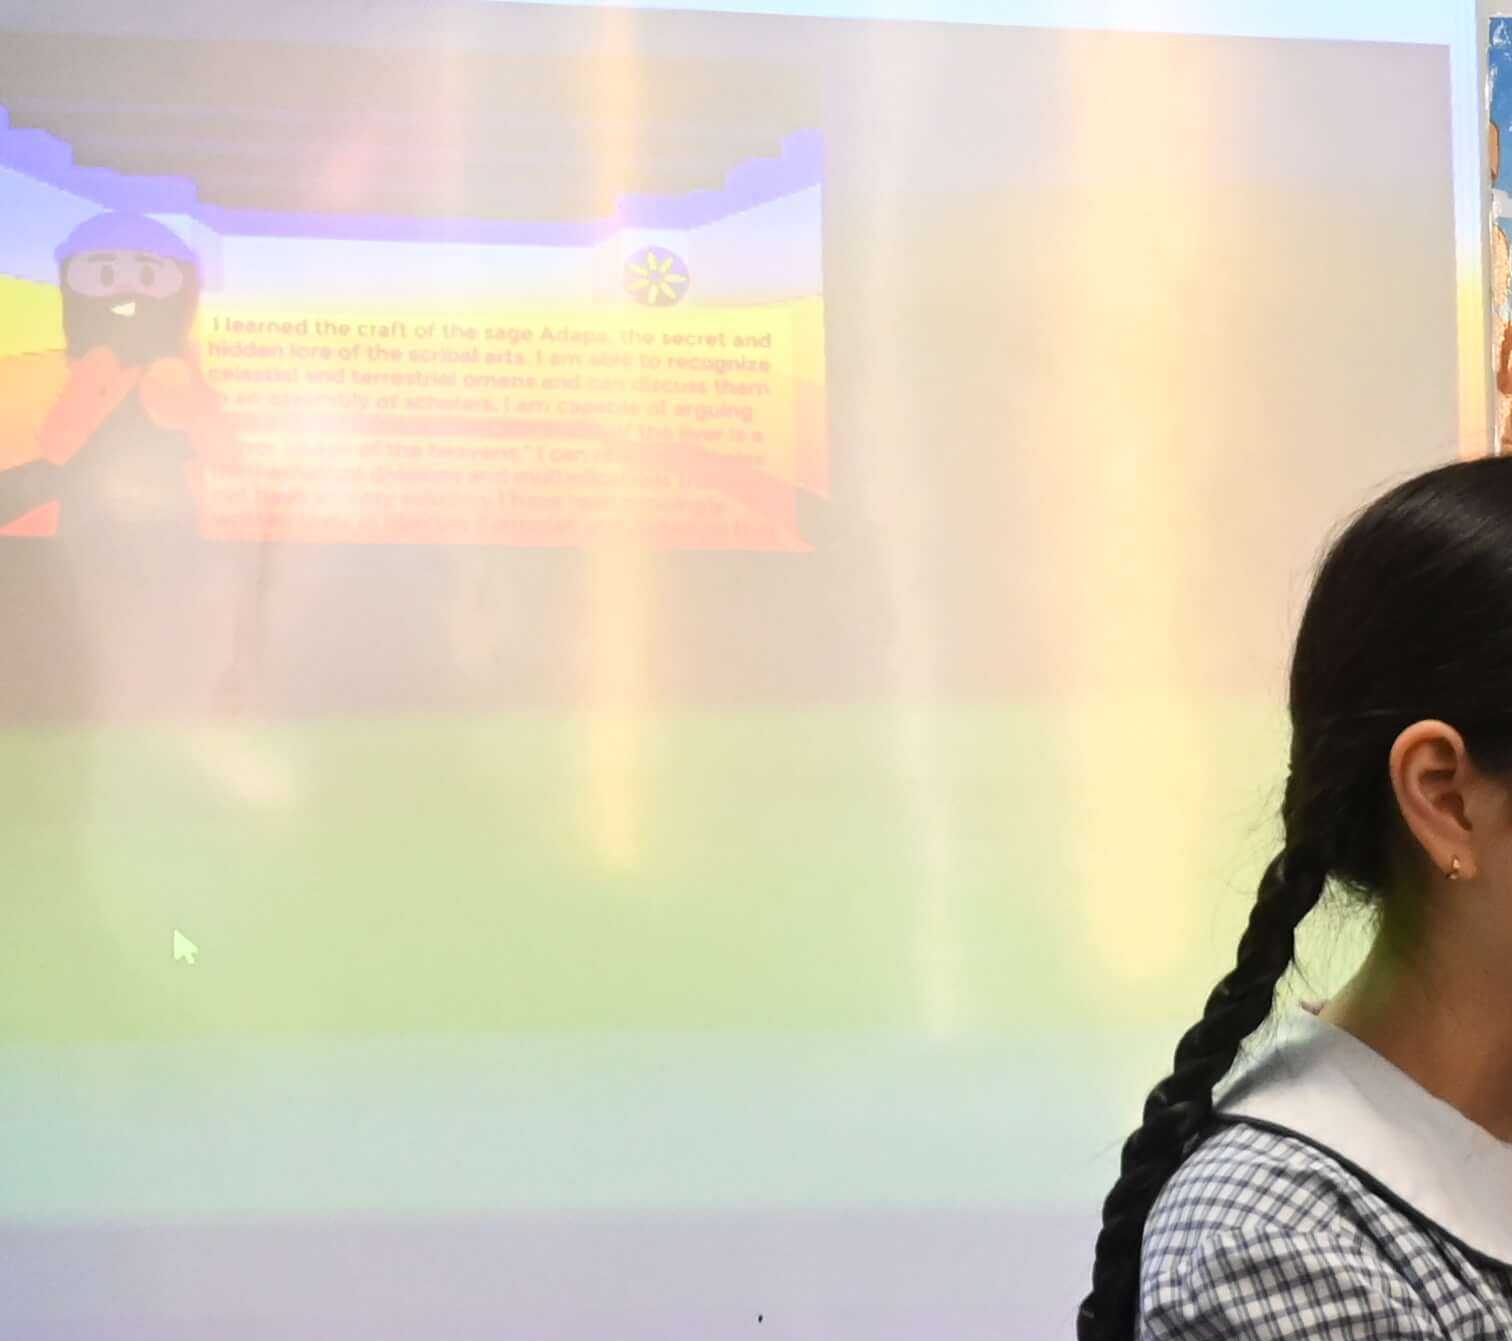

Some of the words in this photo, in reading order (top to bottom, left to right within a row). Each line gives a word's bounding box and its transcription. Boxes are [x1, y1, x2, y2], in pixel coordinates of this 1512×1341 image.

[225, 317, 309, 337] learned
[314, 319, 351, 337] the
[357, 319, 406, 339] craft
[414, 321, 434, 340] of
[442, 321, 479, 340] the
[484, 328, 534, 345] sage
[662, 331, 727, 349] secret
[732, 332, 773, 349] and
[337, 343, 362, 361] of
[367, 343, 402, 361] the
[666, 354, 770, 374] recognize
